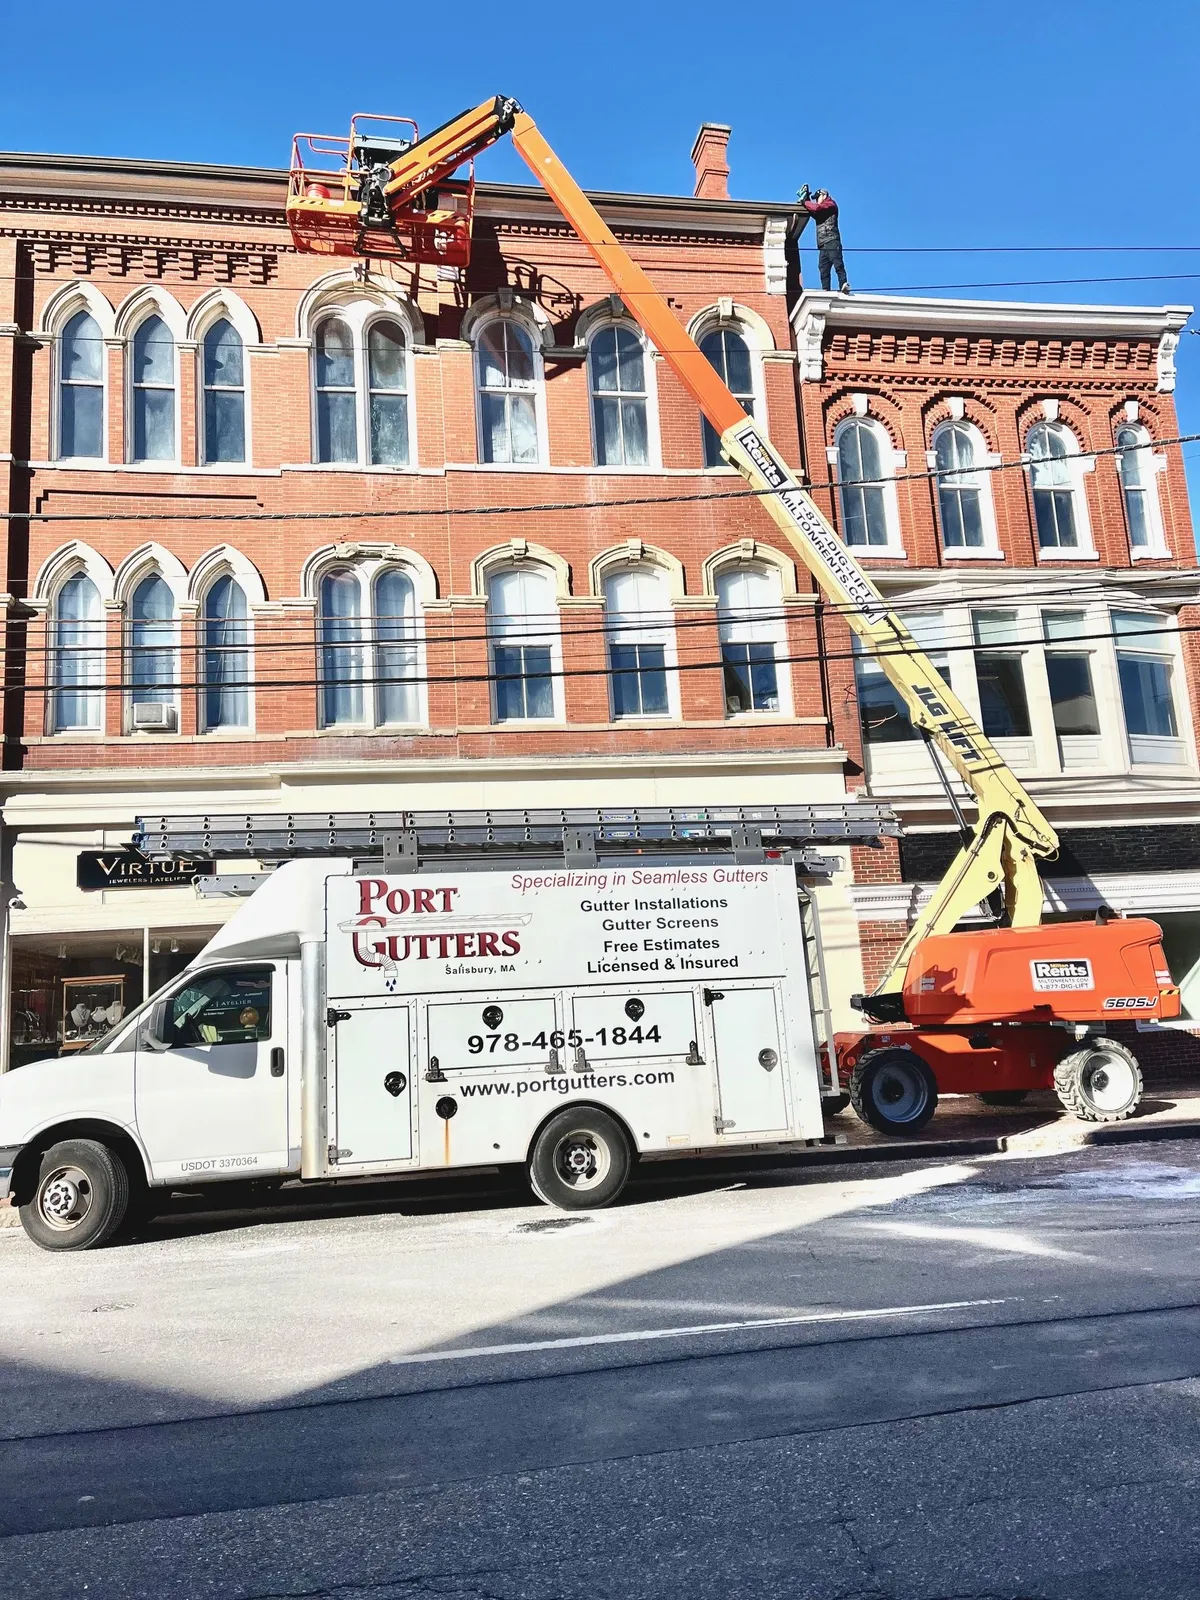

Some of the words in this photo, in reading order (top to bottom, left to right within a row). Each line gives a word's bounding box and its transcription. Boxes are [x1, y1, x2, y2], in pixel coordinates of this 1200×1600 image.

[741, 433, 781, 486] Rents
[778, 490, 875, 619] MILTONRENTS.COM
[797, 499, 874, 599] 1-877-DIG-LIFT
[911, 684, 949, 717] JLG
[939, 721, 982, 760] LIFT
[96, 857, 197, 876] VIRTUE
[511, 872, 607, 891] Specializing
[612, 870, 626, 886] in
[631, 869, 708, 885] Seamless
[713, 868, 769, 883] Gutters
[355, 879, 459, 915] PORT
[580, 900, 630, 912] Gutter
[635, 897, 728, 911] Installations
[602, 918, 652, 931] Gutter
[656, 916, 719, 930] Screens
[352, 916, 521, 967] GUTTERS
[603, 940, 638, 953] Free
[643, 938, 720, 951] Estimates
[445, 965, 497, 975] Salisbury,
[500, 964, 516, 973] MA
[587, 958, 659, 974] Licensed
[664, 957, 676, 970] &
[680, 955, 739, 970] Insured
[1036, 963, 1087, 977] Rents
[1105, 997, 1157, 1008] 660SJ
[467, 1024, 662, 1054] 978-465-1844
[460, 1071, 675, 1097] www.portgutters.com
[181, 1160, 217, 1172] USDOT
[219, 1157, 258, 1168] 3370364
